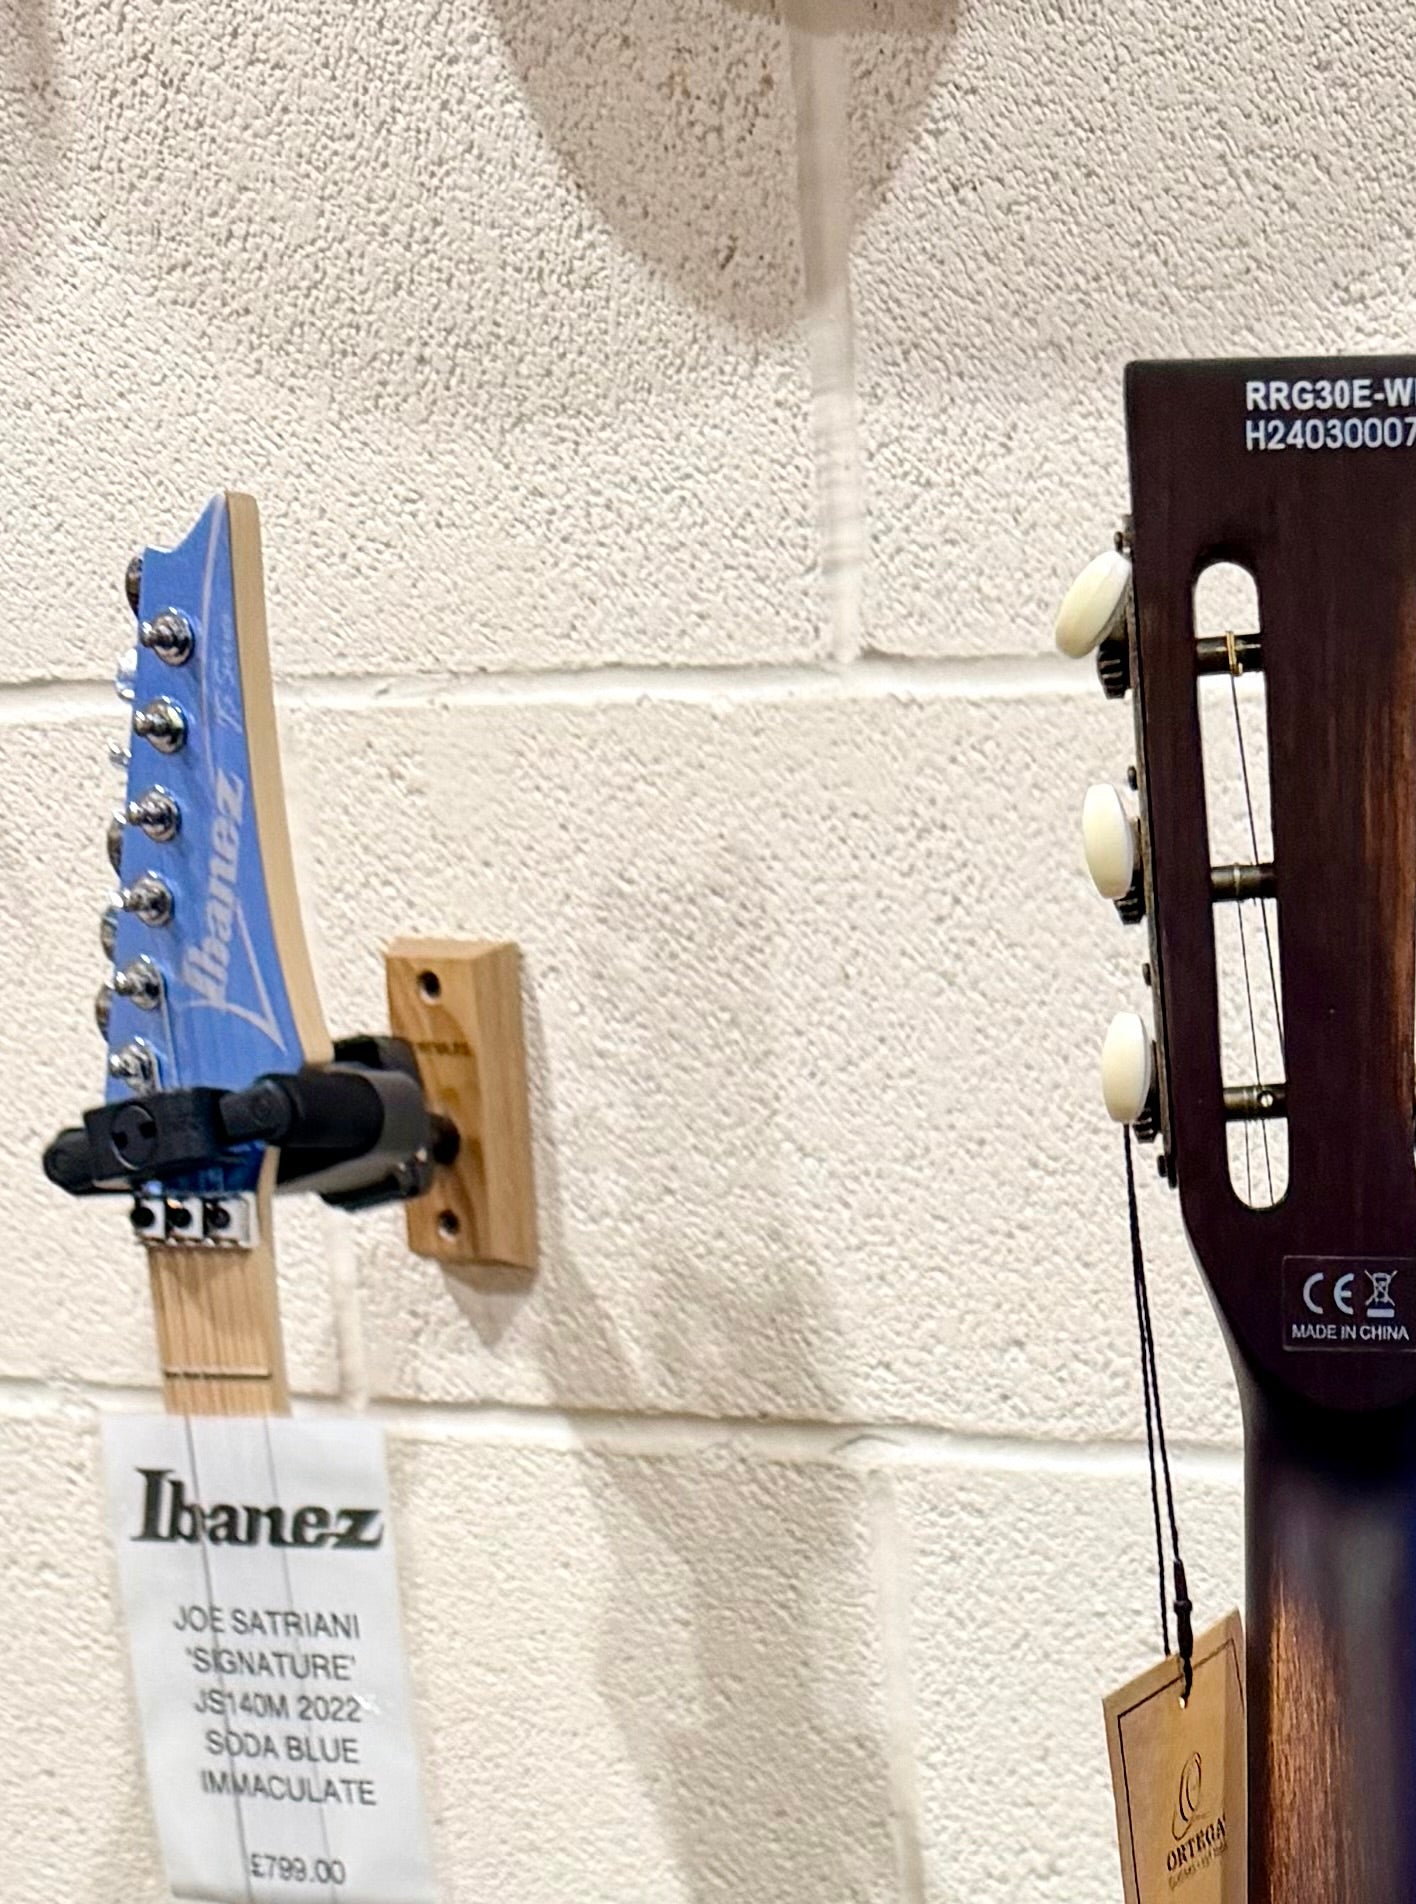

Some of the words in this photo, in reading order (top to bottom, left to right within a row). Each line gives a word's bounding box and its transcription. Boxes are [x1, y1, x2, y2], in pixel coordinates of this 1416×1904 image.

[179, 768, 243, 1008] Ibanez
[1291, 1324, 1338, 1339] MADE
[1341, 1324, 1357, 1340] IN
[1359, 1325, 1410, 1341] CHINA
[130, 1466, 386, 1550] Ibanez
[173, 1605, 223, 1635] JOE
[231, 1608, 362, 1640] SATRIANI
[186, 1646, 357, 1681] 'SIGNATURE'
[194, 1690, 289, 1720] JS140M
[298, 1694, 363, 1724] 2022
[205, 1730, 280, 1760] SODA
[286, 1735, 360, 1766] BLUE
[200, 1769, 378, 1806] IMMACULATE
[250, 1852, 347, 1885] £799.00
